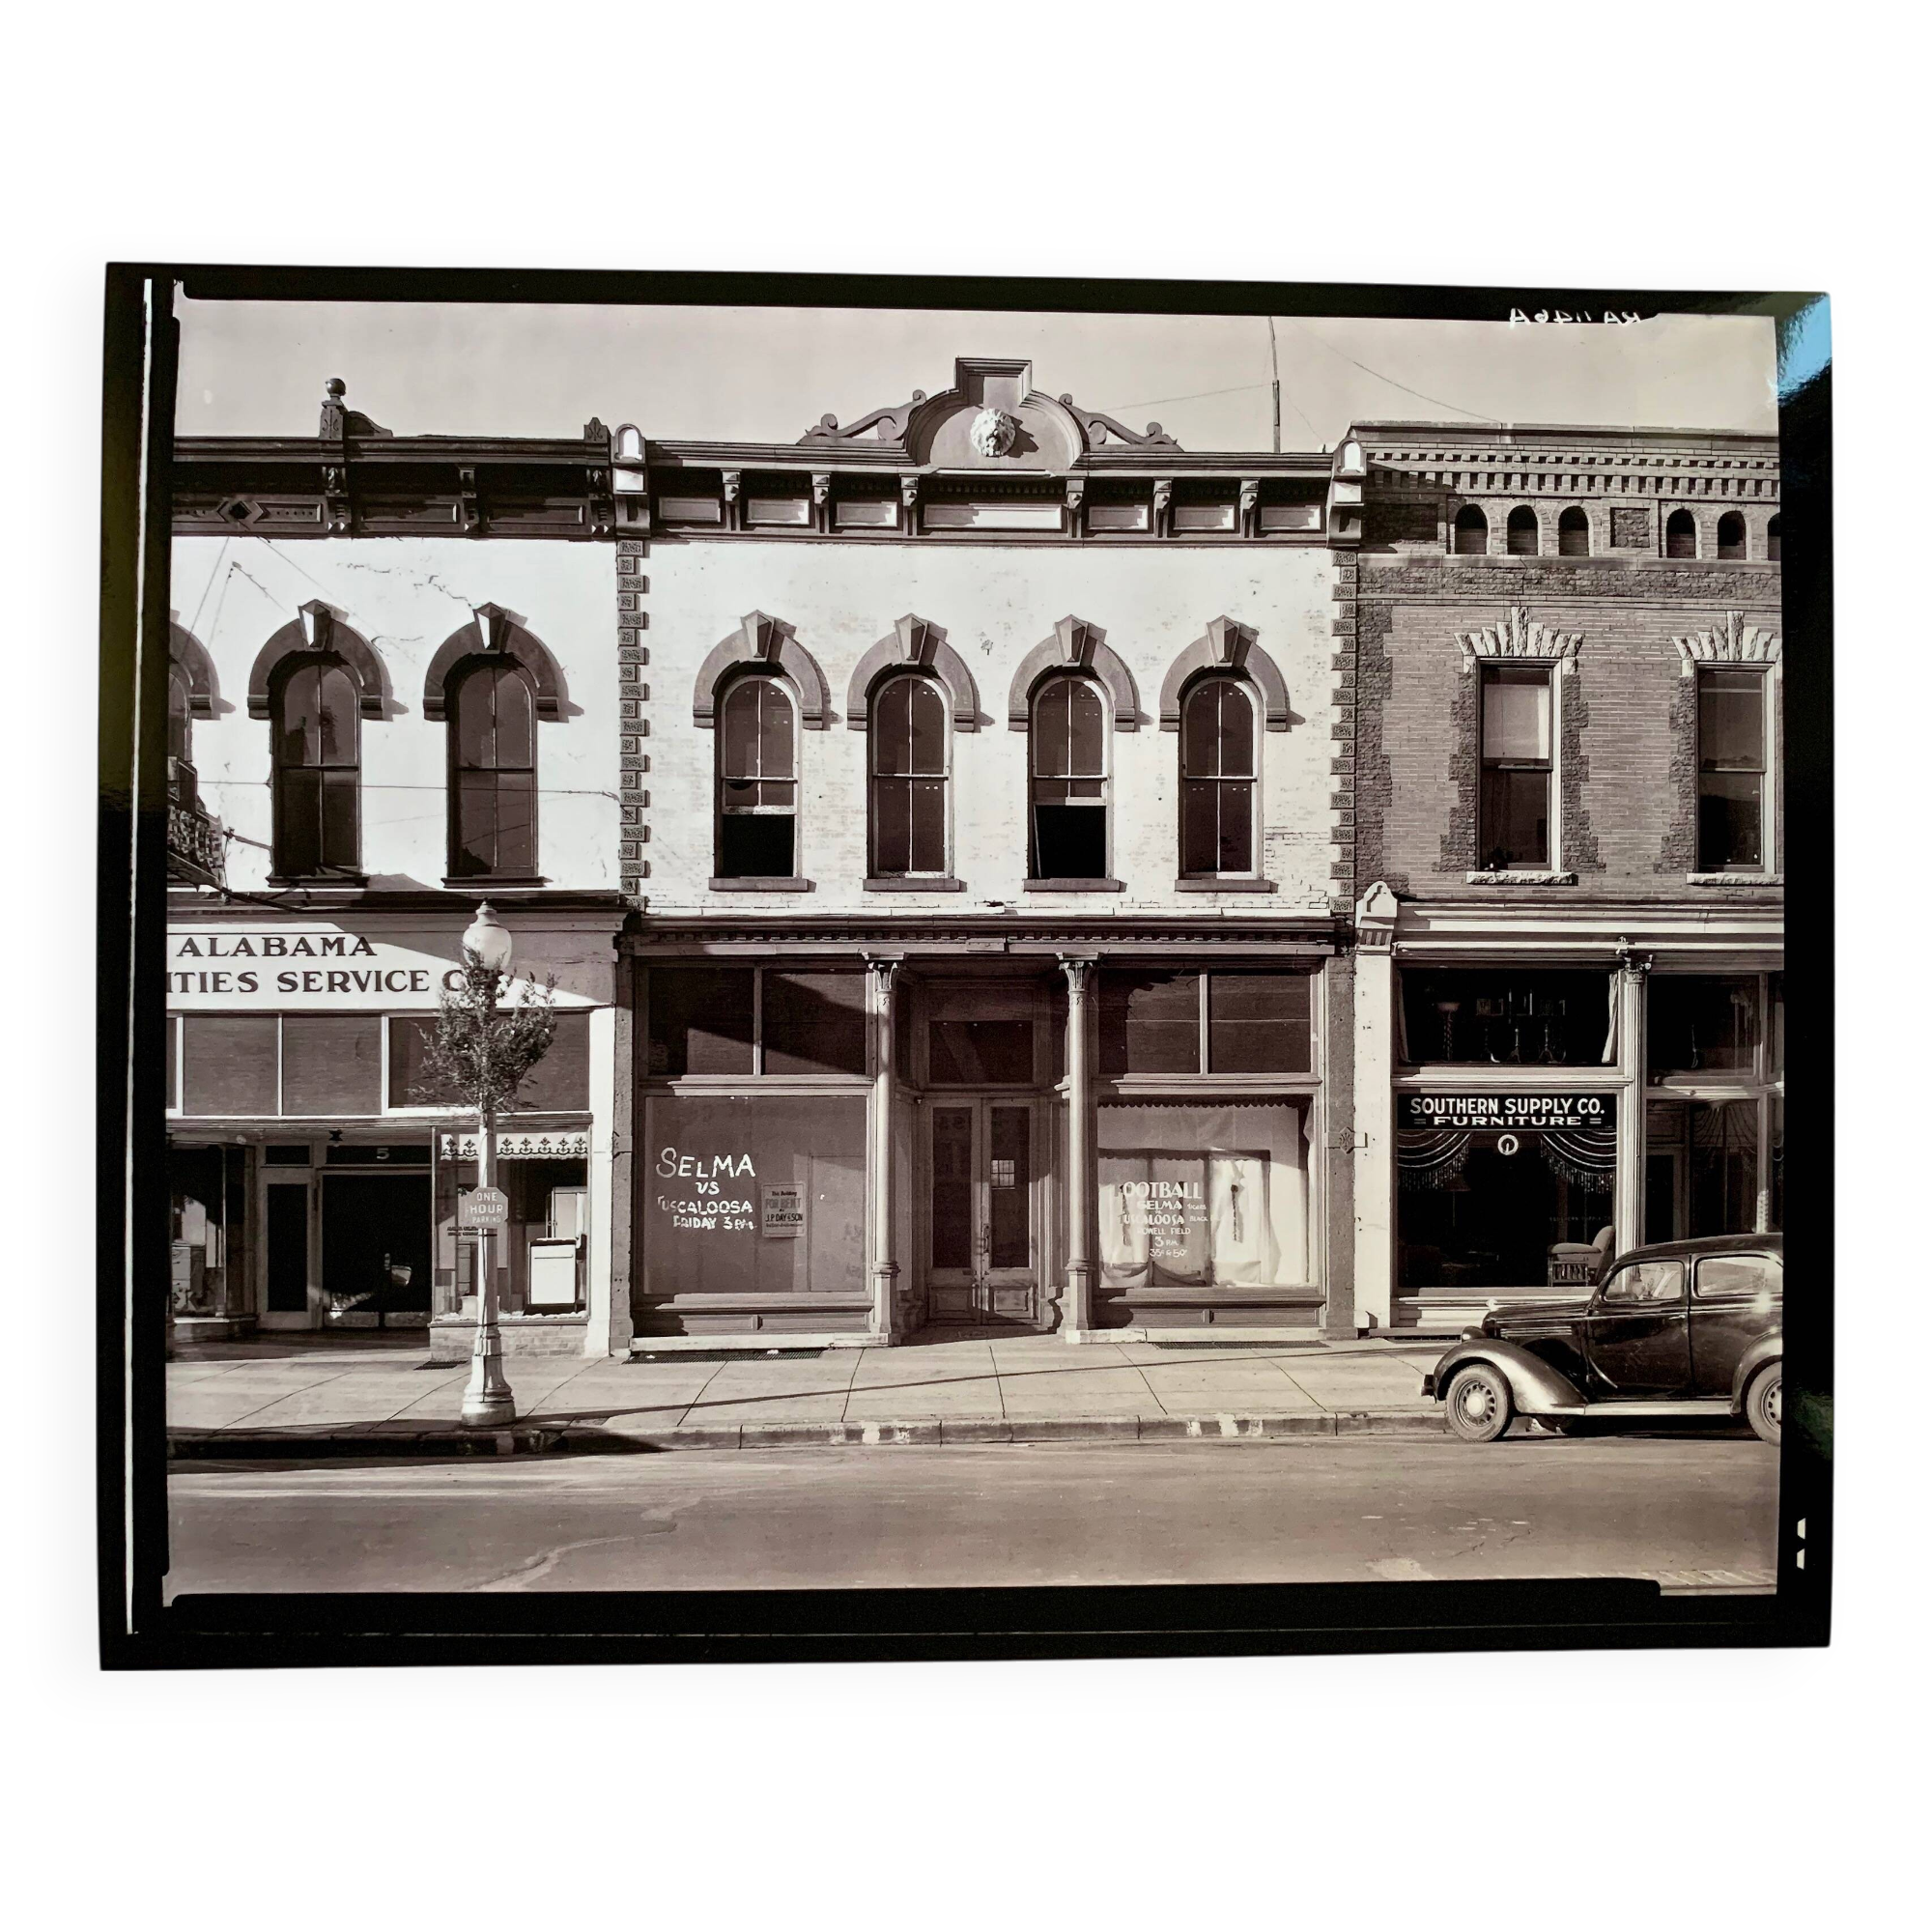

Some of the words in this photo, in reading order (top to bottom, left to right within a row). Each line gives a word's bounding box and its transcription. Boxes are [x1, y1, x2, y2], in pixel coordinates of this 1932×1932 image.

[176, 936, 378, 957] ALABAMA
[276, 970, 429, 993] SERVICE
[1409, 1097, 1498, 1115] SOUTHERN
[1504, 1097, 1574, 1115] SUPPLY
[1577, 1097, 1605, 1115] CO.
[1433, 1115, 1582, 1126] FURNITURE
[656, 1147, 755, 1179] SELMA
[476, 1192, 497, 1202] ONE
[1122, 1181, 1202, 1199] OOTBALL
[469, 1204, 503, 1214] HOUR
[471, 1215, 501, 1224] PARKING
[1123, 1214, 1185, 1225] USCALOOSA
